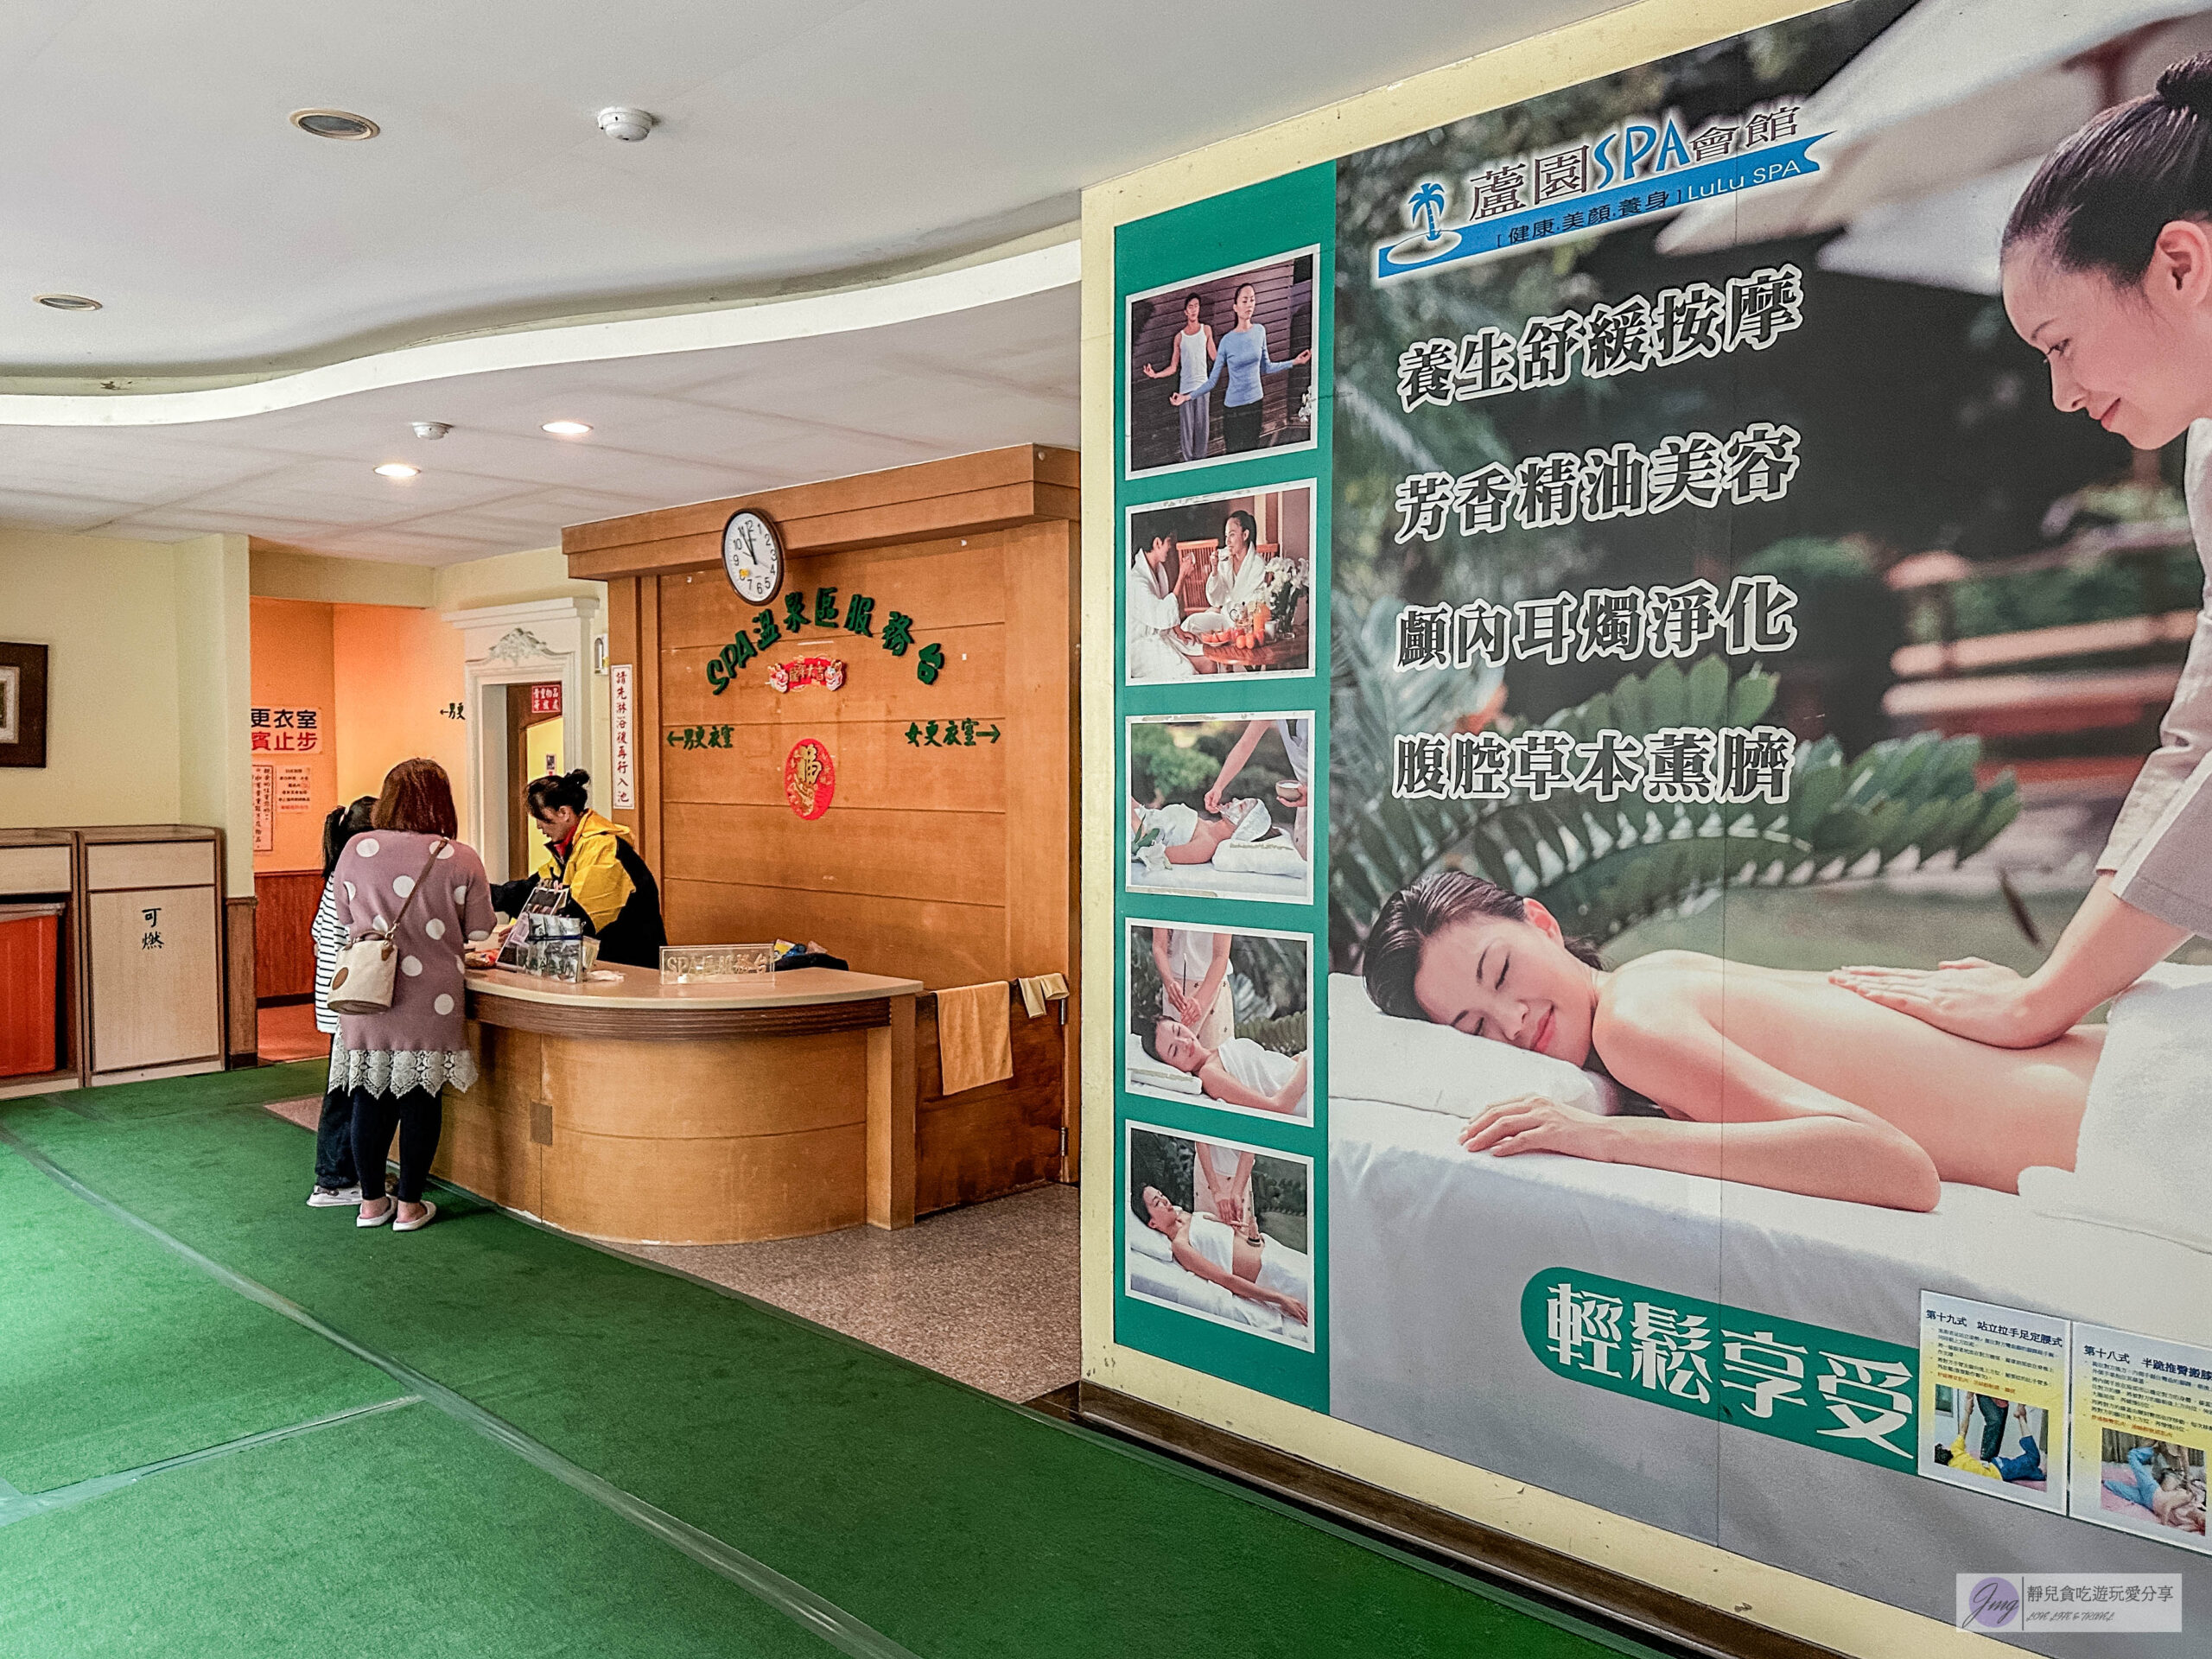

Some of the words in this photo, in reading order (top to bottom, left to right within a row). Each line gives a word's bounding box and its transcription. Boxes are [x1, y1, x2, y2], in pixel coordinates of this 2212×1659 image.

[1469, 106, 1802, 222] 蘆園SPA會館
[1688, 176, 1745, 202] LuLu
[1752, 160, 1802, 185] SPA
[1398, 264, 1802, 412] 養生舒緩按摩
[1395, 423, 1800, 543] 芳香精油美容
[733, 538, 742, 550] 10
[765, 533, 771, 546] 2
[733, 554, 739, 566] 9
[770, 549, 778, 562] 3
[770, 564, 775, 575] 4
[747, 579, 753, 590] 7
[756, 582, 763, 594] 6
[765, 576, 771, 589] 5
[251, 709, 317, 728] 更衣室
[448, 702, 466, 720] 男更
[251, 731, 318, 751] 賓止步
[615, 671, 630, 803] 請先淋浴後再行入池
[683, 724, 734, 750] 男更衣室
[905, 717, 979, 747] 女更衣室
[1393, 728, 1796, 803] 腹腔草本薰臍
[141, 907, 164, 950] 可燃
[1926, 1309, 1967, 1327] 第十九式
[2083, 1344, 2131, 1364] 第十八式
[1547, 1283, 1914, 1459] 輕鬆享受
